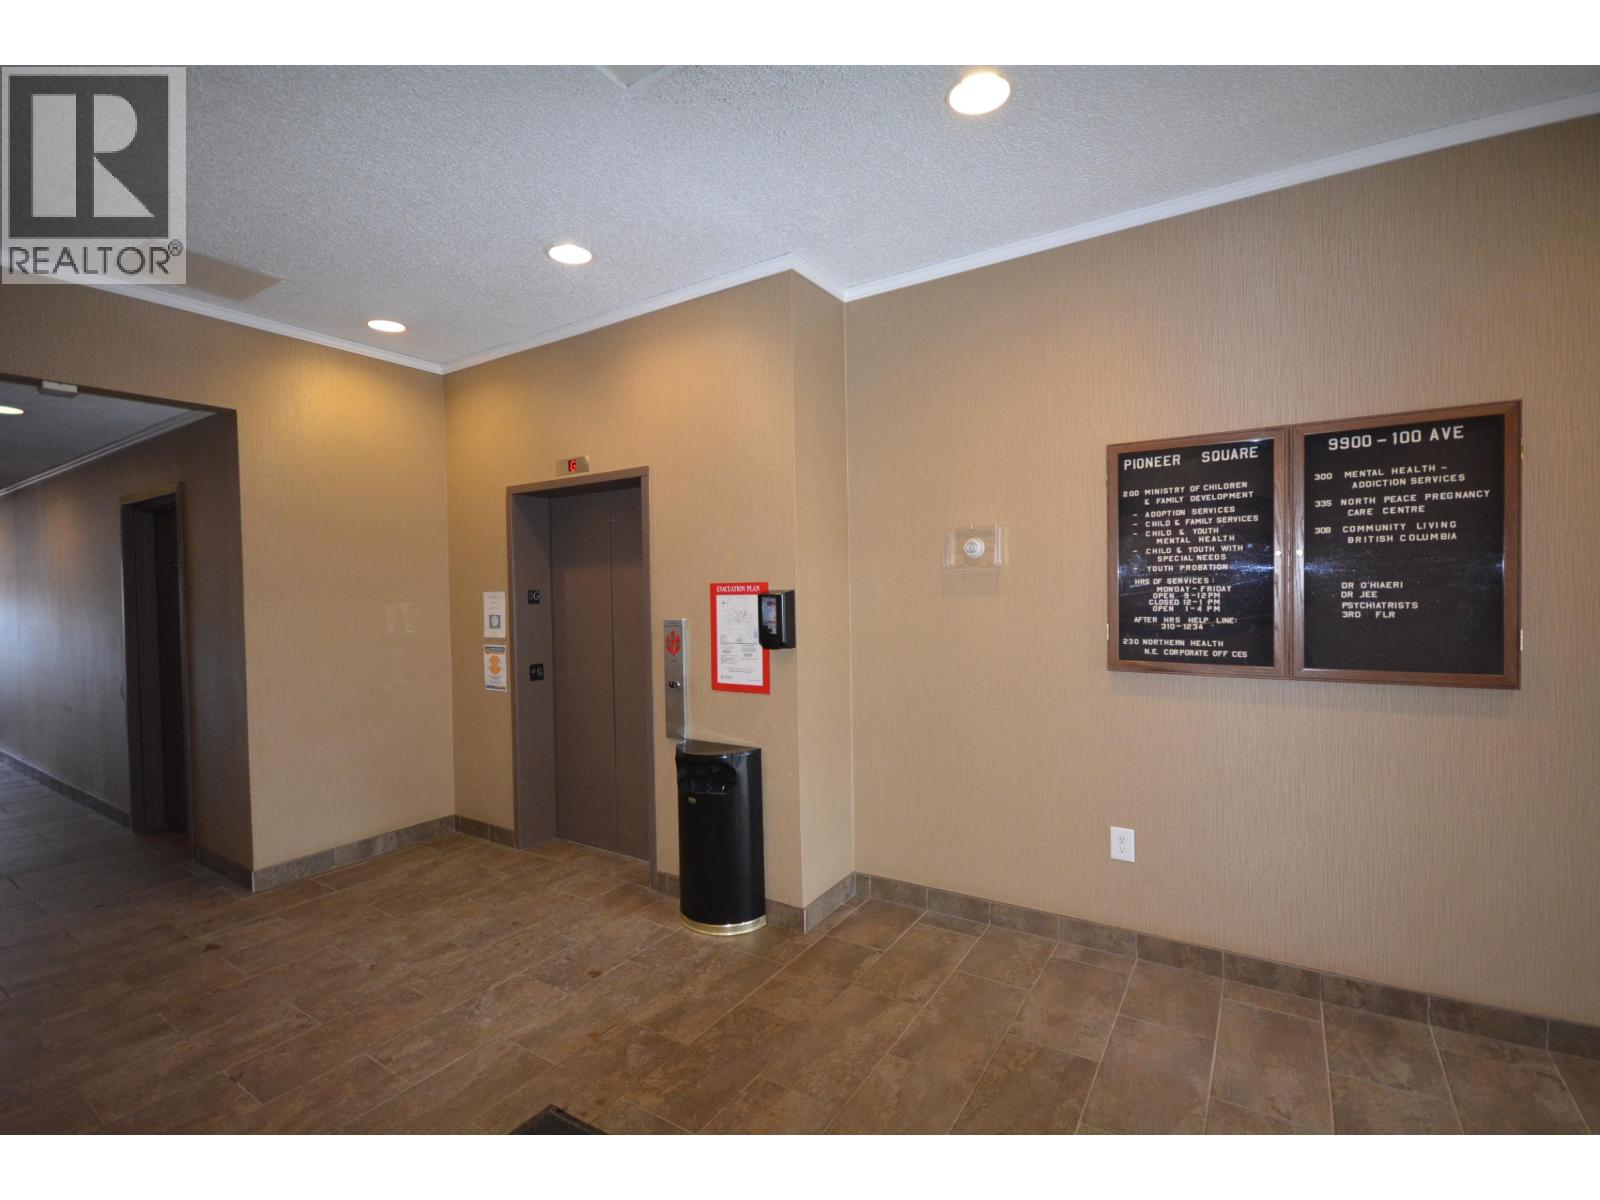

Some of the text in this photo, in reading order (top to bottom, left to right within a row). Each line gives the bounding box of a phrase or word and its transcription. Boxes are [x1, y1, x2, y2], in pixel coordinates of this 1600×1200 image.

[1328, 434, 1372, 451] 9900
[1392, 430, 1422, 445] 100
[1429, 426, 1464, 442] AVE
[1124, 446, 1259, 471] PIONEER SQUARE
[570, 460, 576, 472] G
[1344, 469, 1384, 478] MENTAL
[1391, 464, 1436, 475] HEALTH
[1144, 486, 1185, 495] MINISTRY
[1203, 481, 1248, 491] CHILDREN
[1352, 474, 1466, 489] ADDICTION SERVICES
[1156, 496, 1184, 505] FAMILY
[1190, 491, 1254, 501] DEVELOPMENT
[1341, 497, 1376, 506] NORTH
[1384, 495, 1416, 503] PEACE
[1425, 490, 1490, 501] PREGNANCY
[1192, 506, 1235, 515] SERVICES
[1348, 505, 1425, 516] CARE CENTRE
[1216, 515, 1259, 524] SERVICES
[1342, 524, 1406, 533] COMMUNITY
[1416, 521, 1457, 530] LIVING
[1348, 533, 1457, 543] BRITISH COLUMBIA
